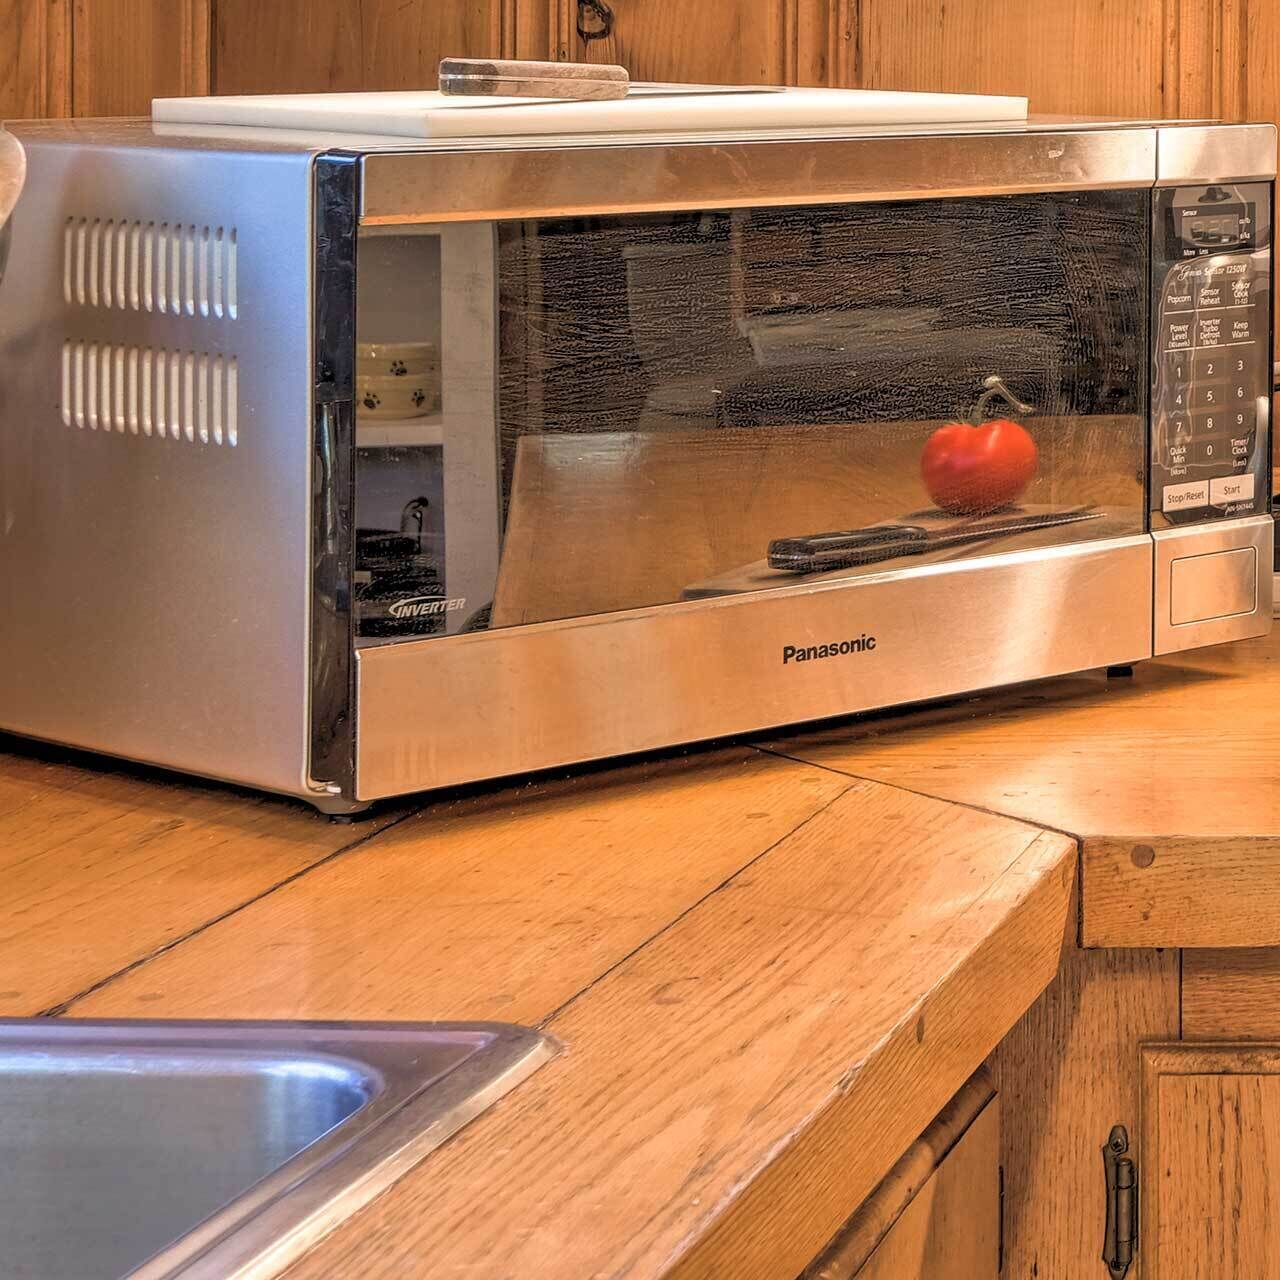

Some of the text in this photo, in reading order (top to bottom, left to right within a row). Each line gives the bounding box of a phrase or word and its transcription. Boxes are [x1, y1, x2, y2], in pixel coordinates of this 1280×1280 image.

[1200, 288, 1220, 297] Sensor
[1167, 295, 1192, 305] Popcorn
[1200, 296, 1220, 305] Reheat
[1170, 323, 1189, 333] Power
[1233, 321, 1248, 330] Keep
[1172, 331, 1188, 340] Level
[1231, 330, 1250, 339] Warm
[1177, 360, 1243, 378] 1 2 3
[1176, 387, 1243, 404] 4 5 6
[1176, 414, 1243, 432] 7 8 9
[1169, 447, 1187, 456] Quick
[1207, 445, 1213, 455] 0
[1231, 446, 1248, 455] Clock
[1173, 454, 1185, 464] Min
[1223, 485, 1240, 495] Start
[1167, 490, 1205, 503] Stop/Reset
[396, 598, 466, 619] INVERTER
[783, 633, 877, 665] Panasonic
